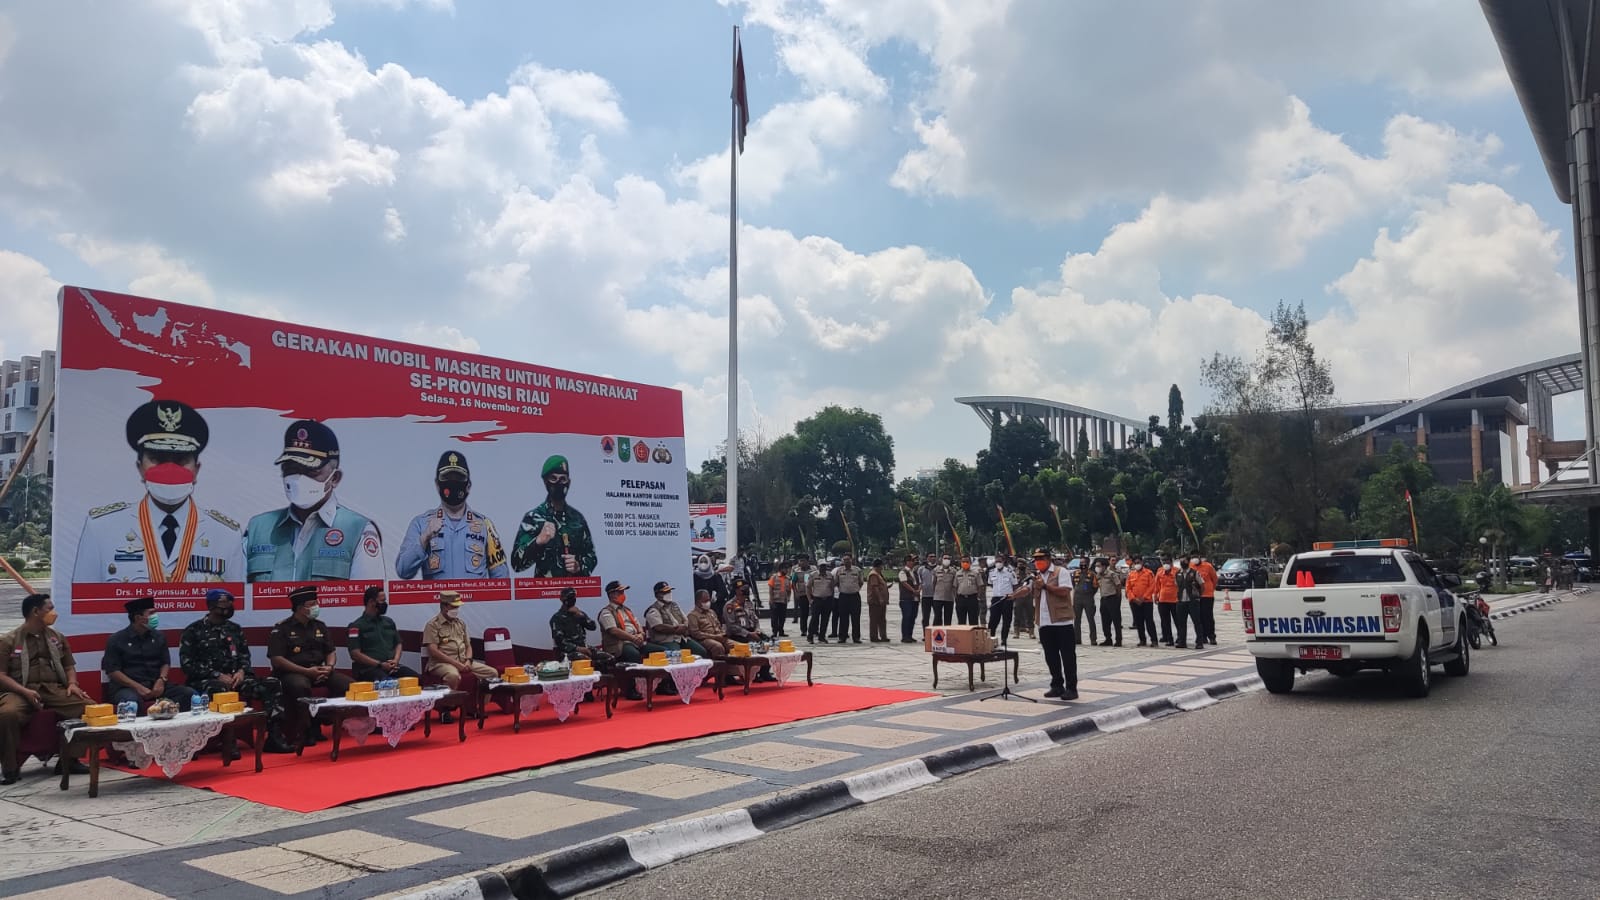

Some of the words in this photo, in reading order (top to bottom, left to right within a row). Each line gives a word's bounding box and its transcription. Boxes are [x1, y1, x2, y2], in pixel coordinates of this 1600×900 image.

[271, 330, 368, 361] GERAKAN
[374, 346, 431, 370] MOBIL
[435, 356, 501, 381] MASKER
[505, 367, 552, 389] UNTUK
[555, 376, 639, 401] MASYARAKAT
[410, 372, 512, 401] SE-PROVINSI
[516, 387, 550, 405] RIAU
[420, 392, 457, 407] Selasa,
[461, 397, 472, 408] 16
[474, 399, 520, 414] November
[522, 405, 543, 416] 2021
[620, 479, 666, 491] PELEPASAN
[605, 491, 631, 499] HALAMAN
[632, 492, 653, 500] KANTOR
[638, 513, 660, 521] MASKER
[638, 529, 657, 537] SABUN
[115, 588, 133, 596] Drs.
[136, 587, 144, 596] H.
[146, 588, 190, 598] Syamsuar,
[176, 601, 196, 609] RIAU
[1258, 616, 1381, 634] PENGAWASAN
